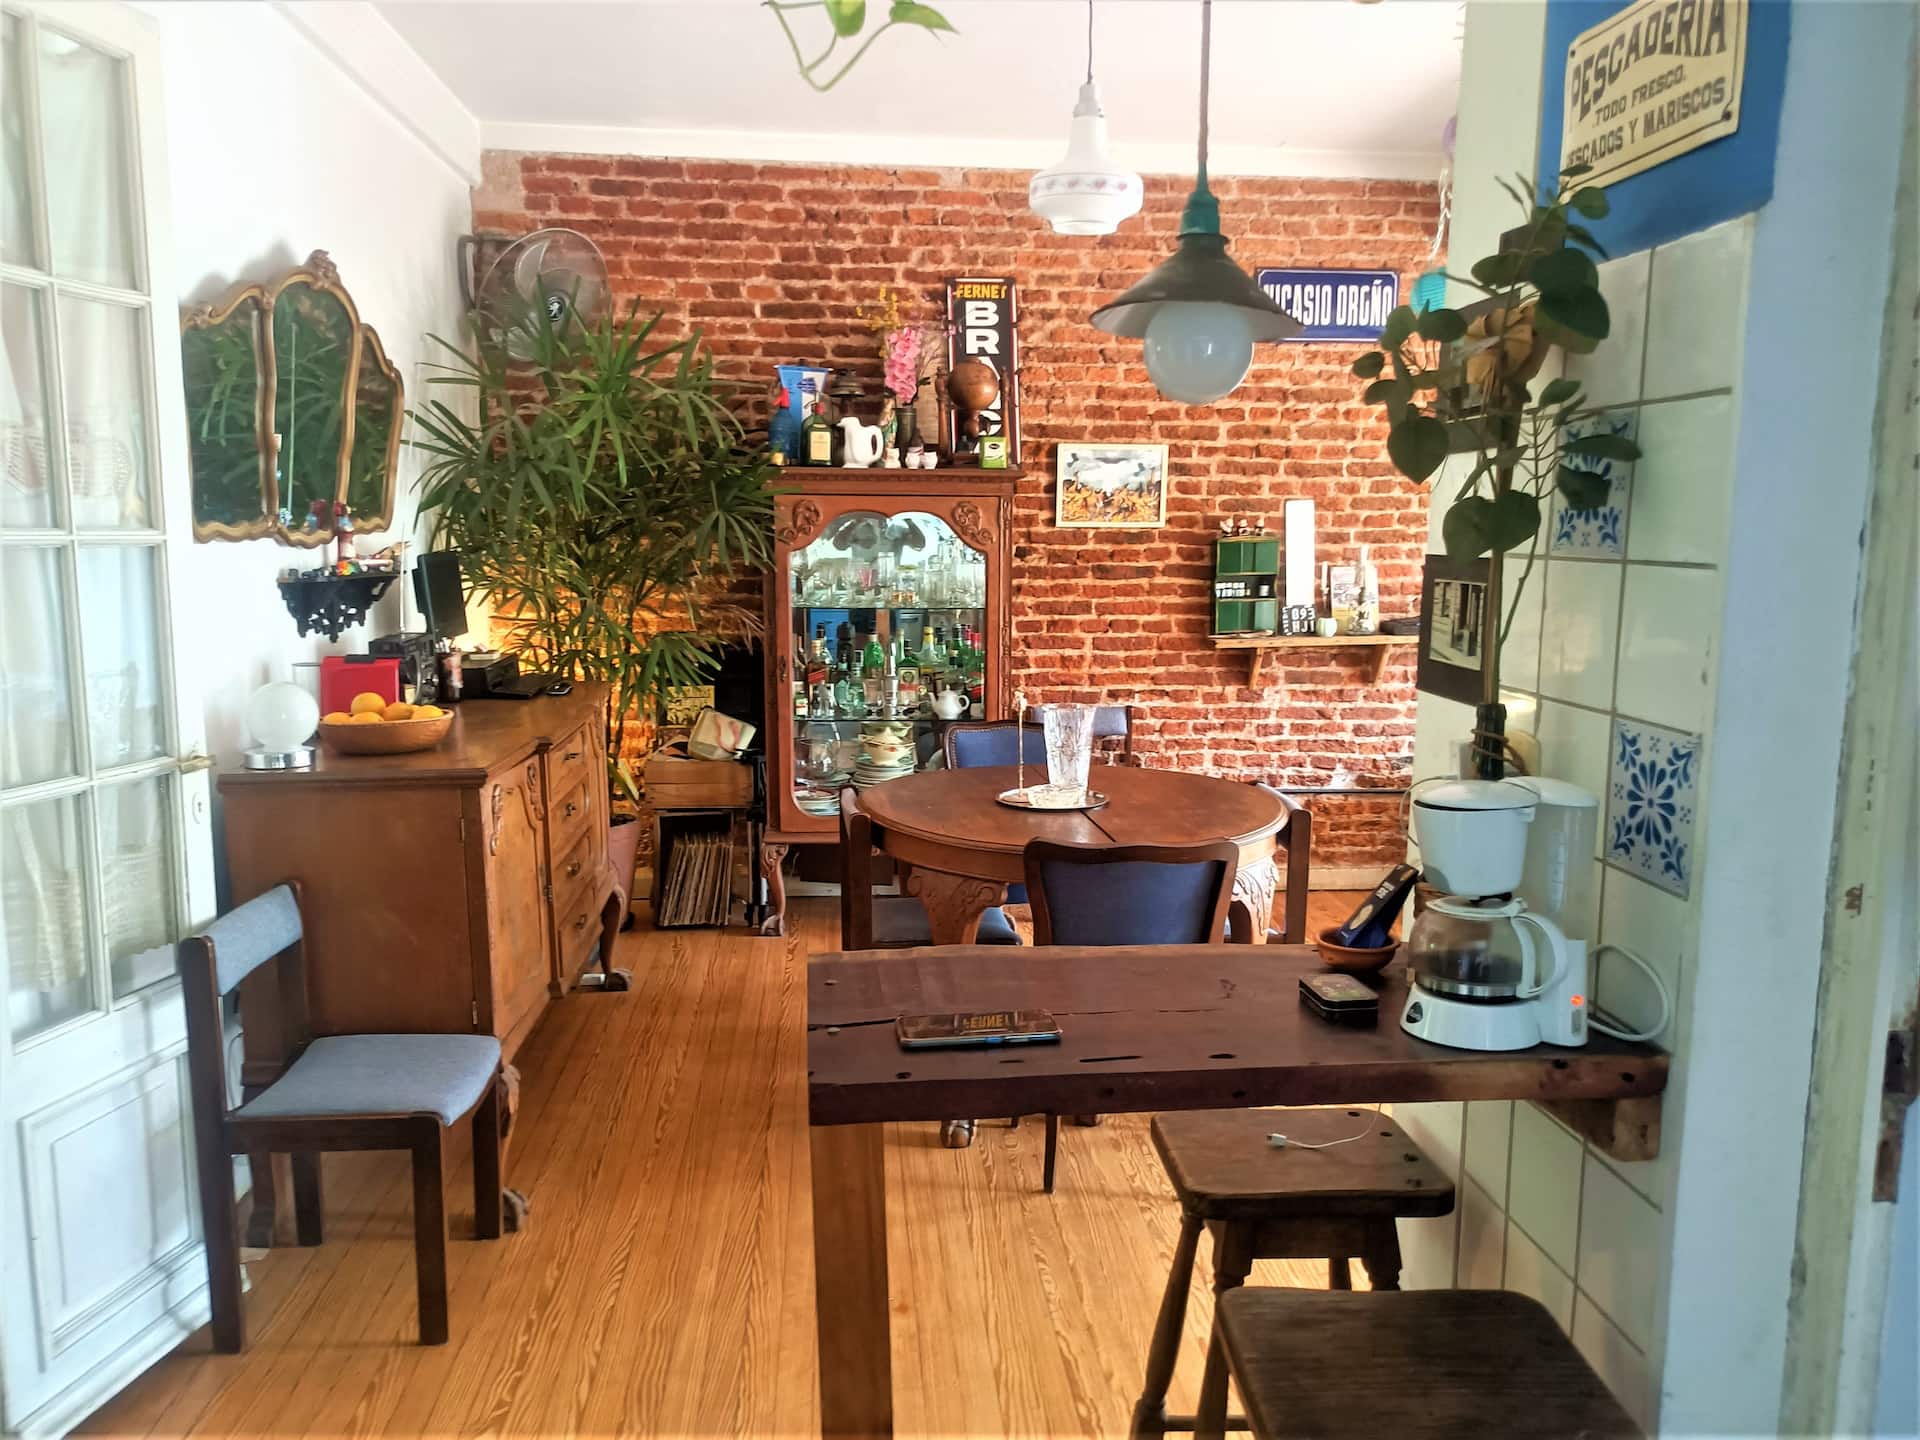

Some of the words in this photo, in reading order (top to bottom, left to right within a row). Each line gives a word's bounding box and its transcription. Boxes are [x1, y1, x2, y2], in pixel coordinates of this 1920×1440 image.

[1595, 95, 1627, 126] TODO
[1628, 118, 1639, 145] Y
[1643, 76, 1725, 138] MARISCOS
[1263, 284, 1332, 326] CASIO
